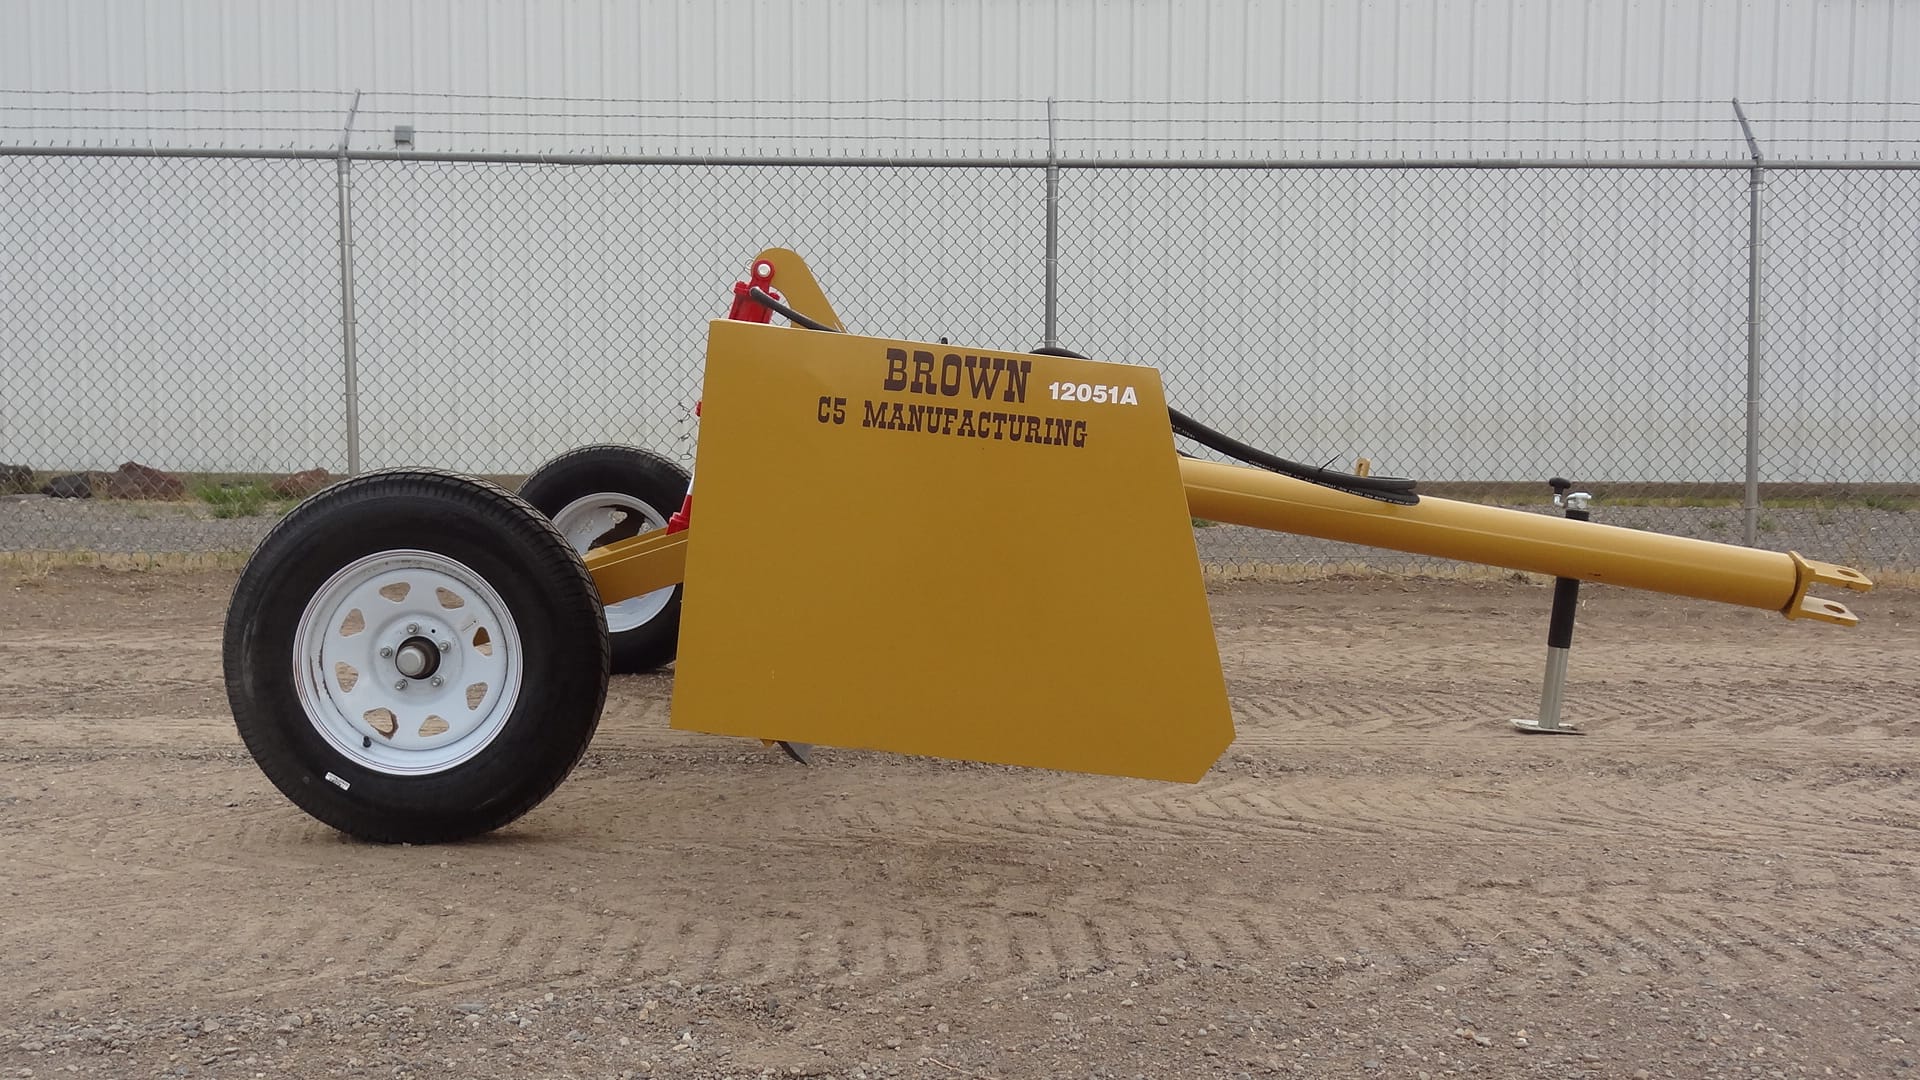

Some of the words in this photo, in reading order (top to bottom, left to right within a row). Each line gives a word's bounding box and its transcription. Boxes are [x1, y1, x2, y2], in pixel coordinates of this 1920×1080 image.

[883, 348, 1032, 403] BROWN
[1049, 381, 1138, 406] 12051A
[817, 396, 847, 425] C5
[862, 400, 1088, 448] MANUFACTURING
